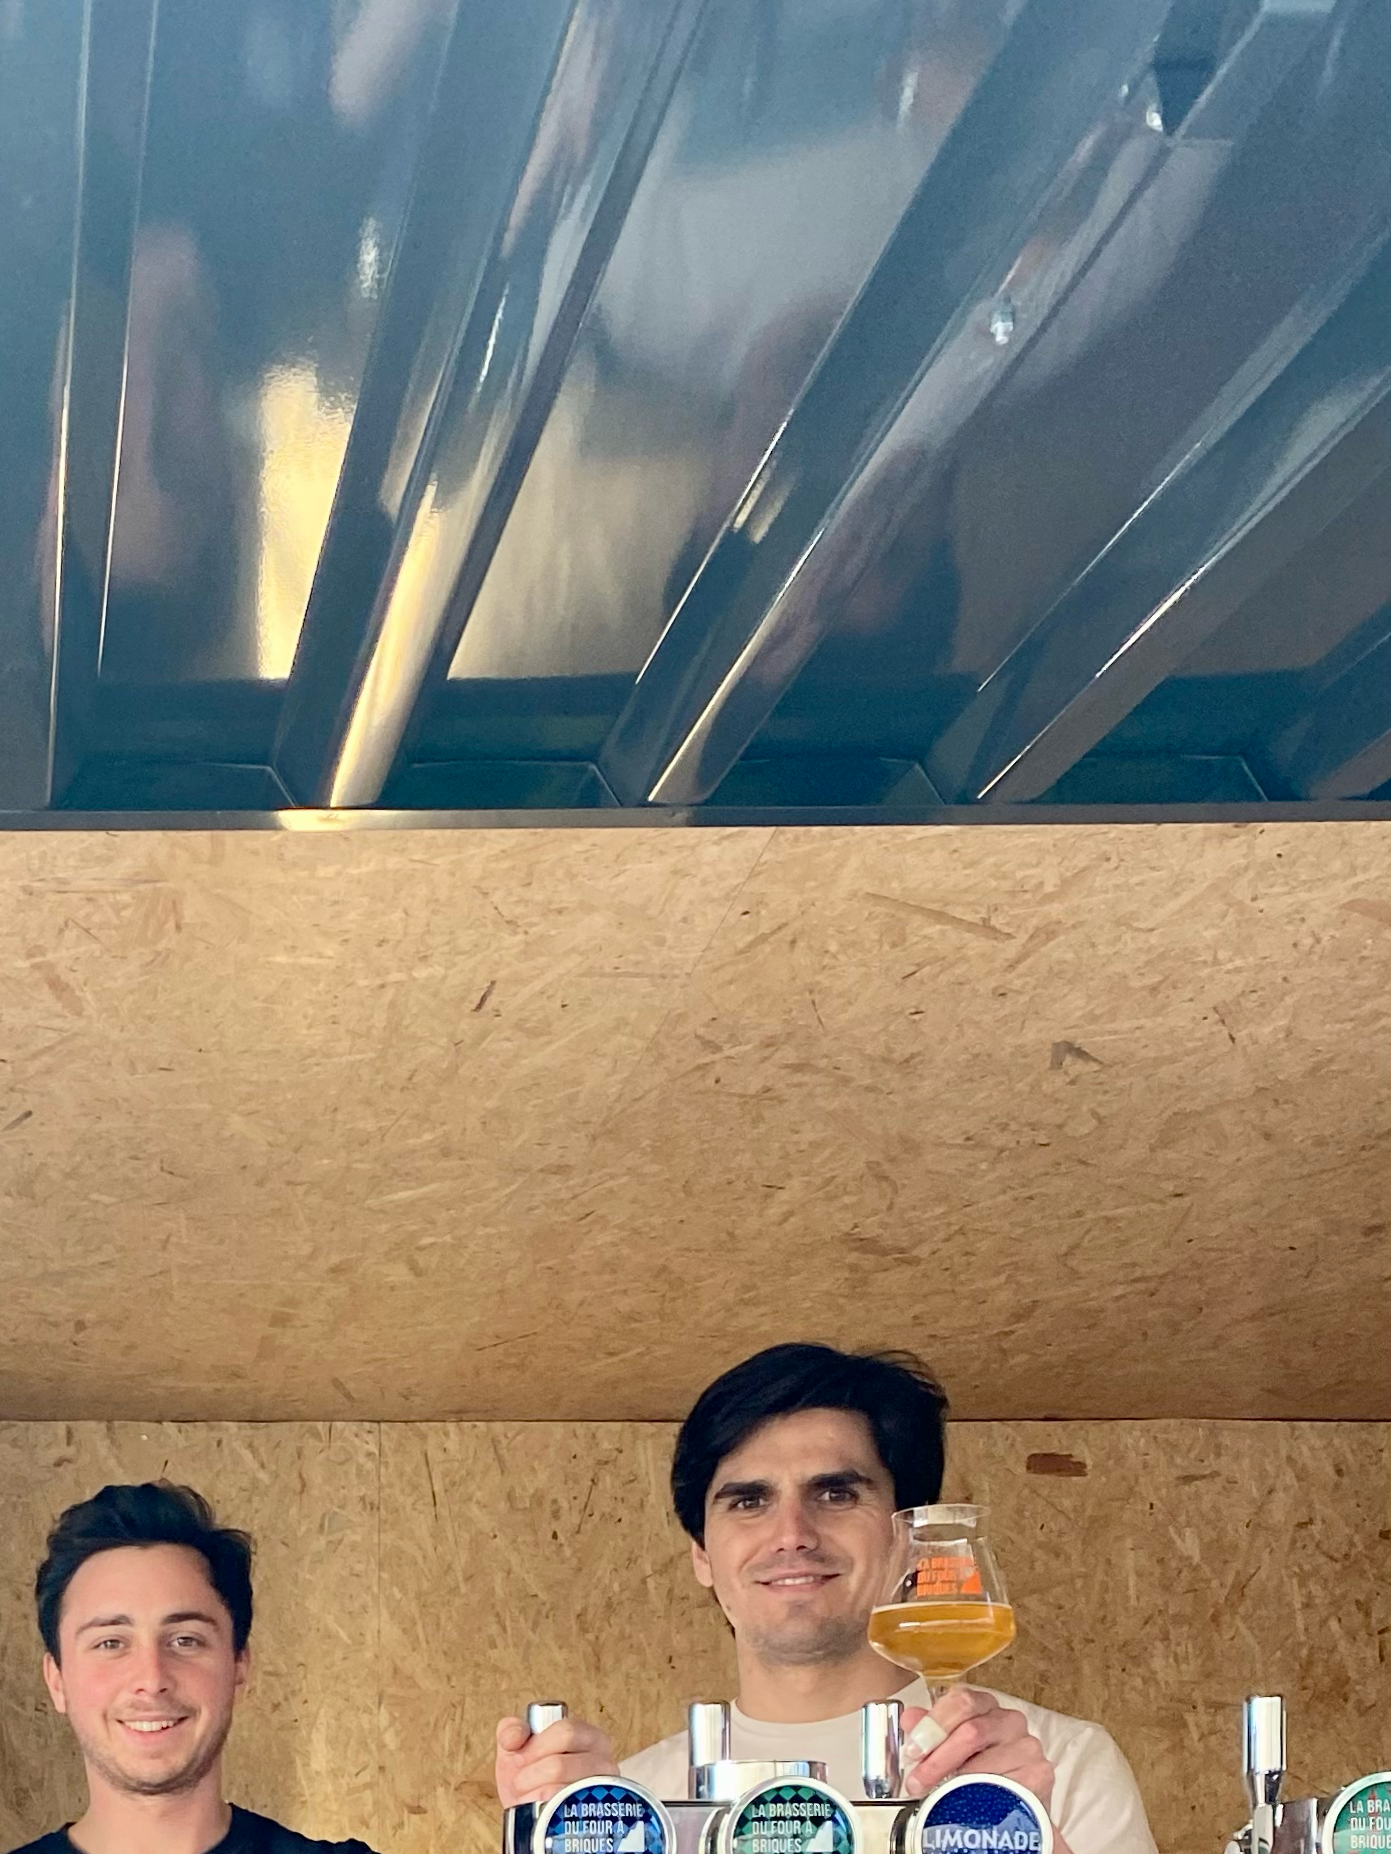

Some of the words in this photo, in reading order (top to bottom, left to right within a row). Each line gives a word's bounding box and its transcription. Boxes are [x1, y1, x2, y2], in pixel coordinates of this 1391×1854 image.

[564, 1804, 578, 1818] LA
[580, 1803, 643, 1818] BRASSERIE
[752, 1804, 766, 1818] LA
[769, 1803, 832, 1817] BRASSERIE
[1350, 1800, 1364, 1813] LA
[564, 1820, 579, 1835] DU
[582, 1820, 613, 1834] FOUR
[752, 1820, 768, 1835] DU
[771, 1820, 802, 1834] FOUR
[1351, 1817, 1366, 1831] DU
[564, 1838, 614, 1854] BRIQUES
[752, 1838, 802, 1854] BRIQUES
[924, 1829, 1041, 1851] LIMONADE
